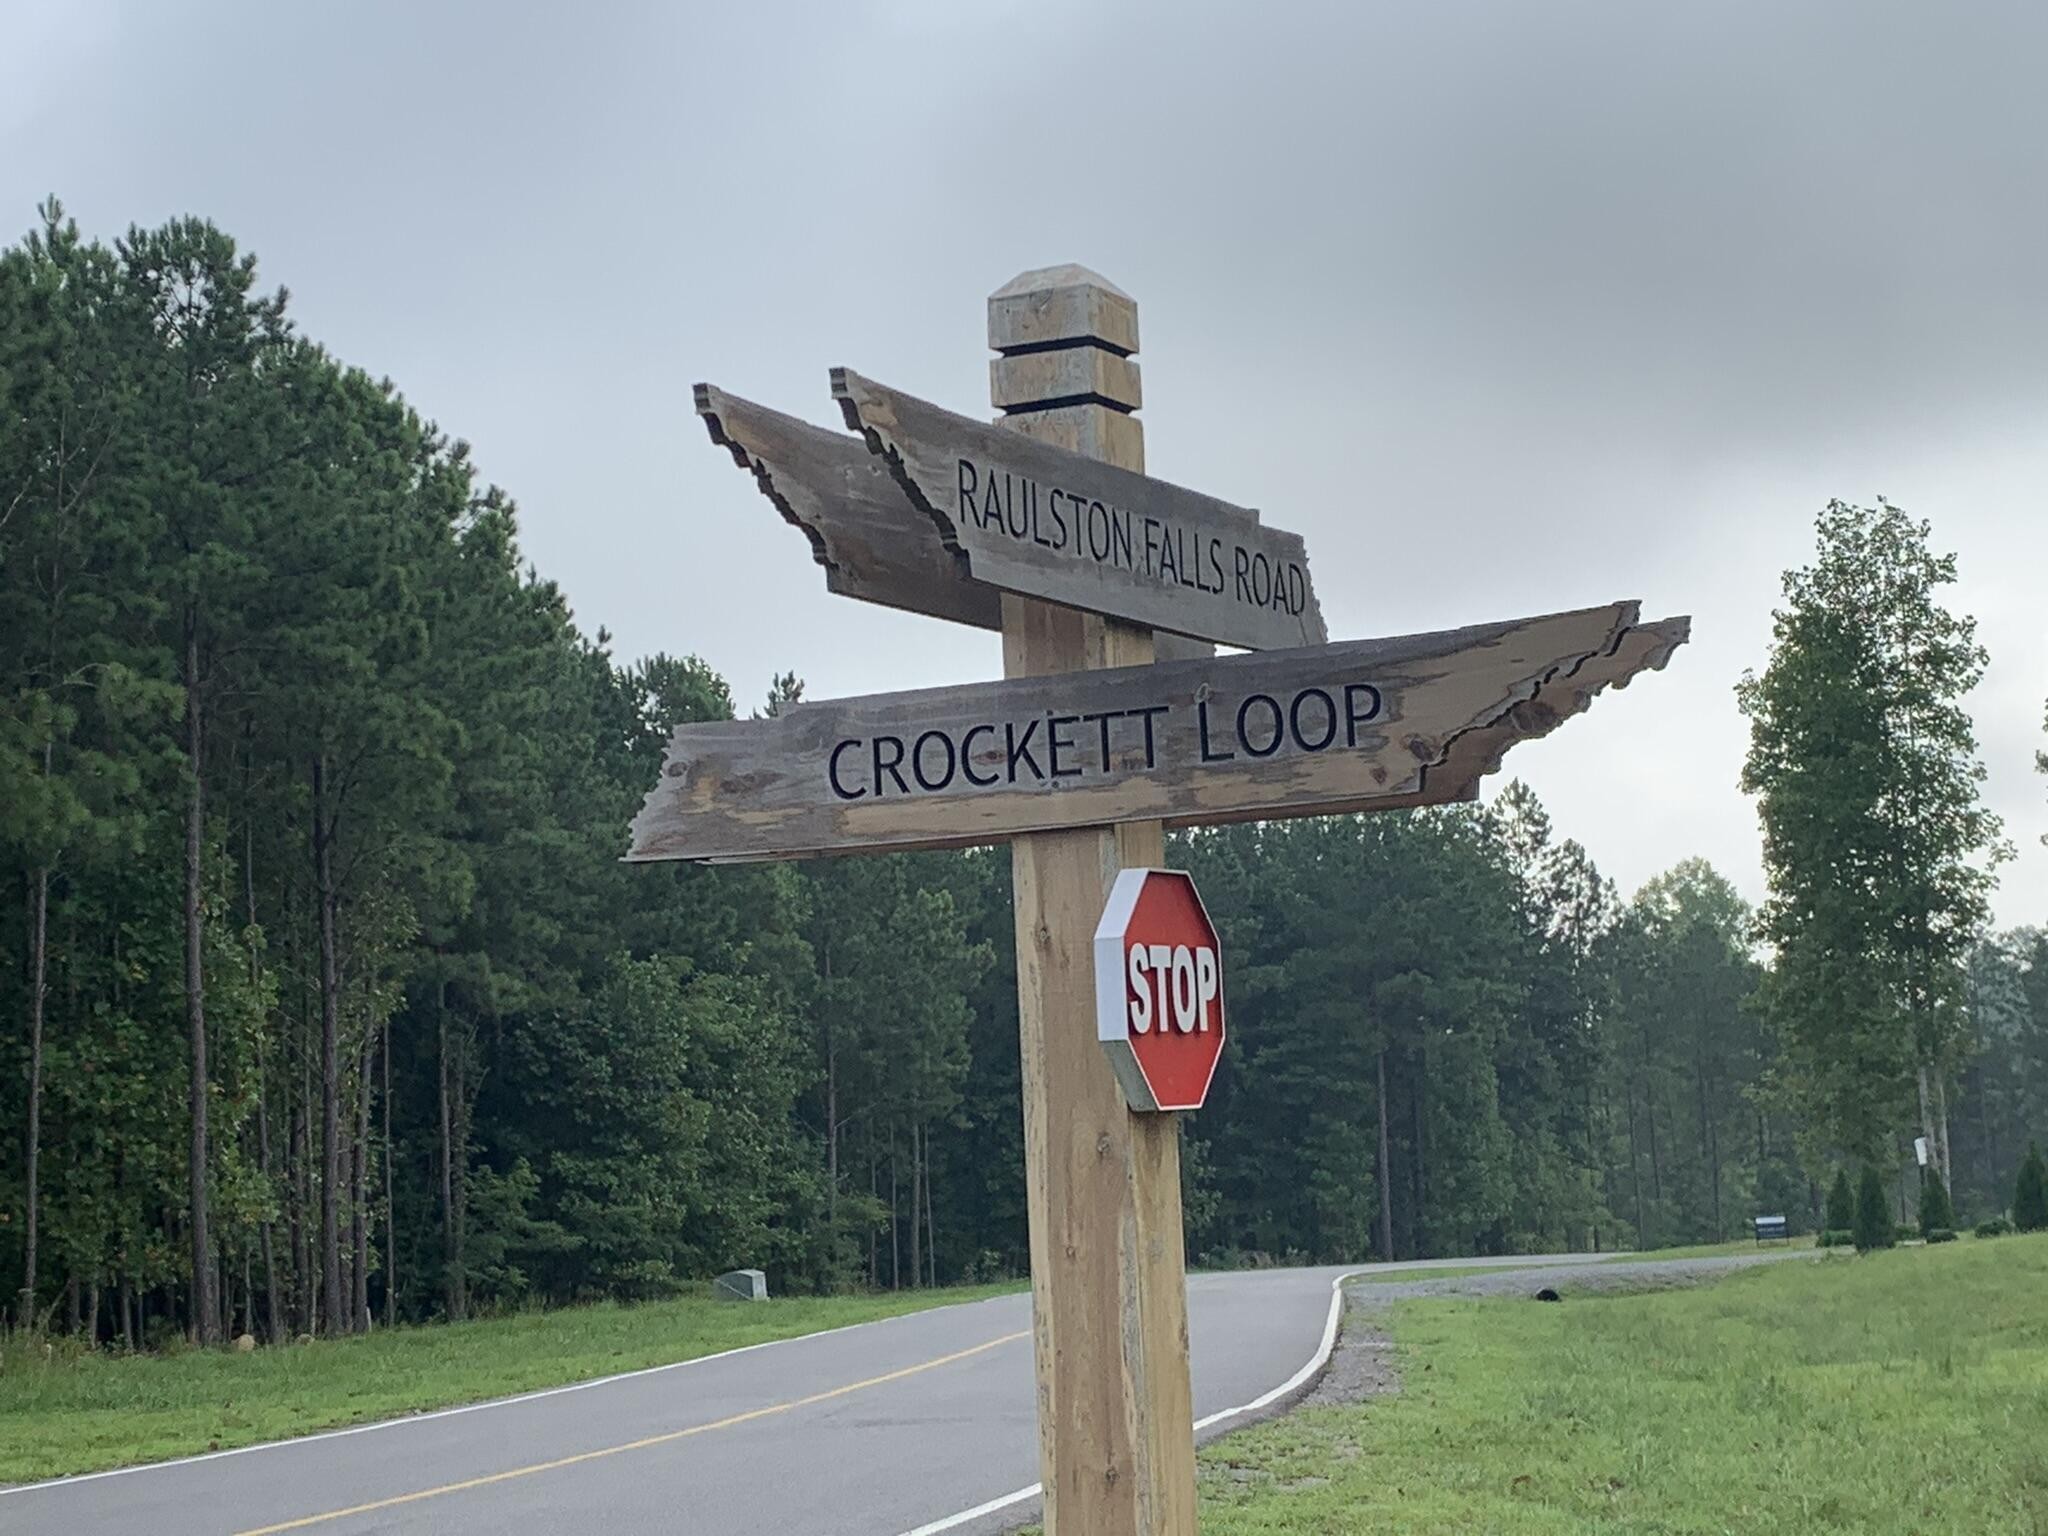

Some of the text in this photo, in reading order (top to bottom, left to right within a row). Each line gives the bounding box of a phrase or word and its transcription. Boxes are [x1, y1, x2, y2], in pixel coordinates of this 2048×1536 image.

[957, 458, 1306, 617] RAULSTON FALLS ROAD
[828, 683, 1383, 801] CROCKETT LOOP
[1129, 942, 1217, 1034] STOP
